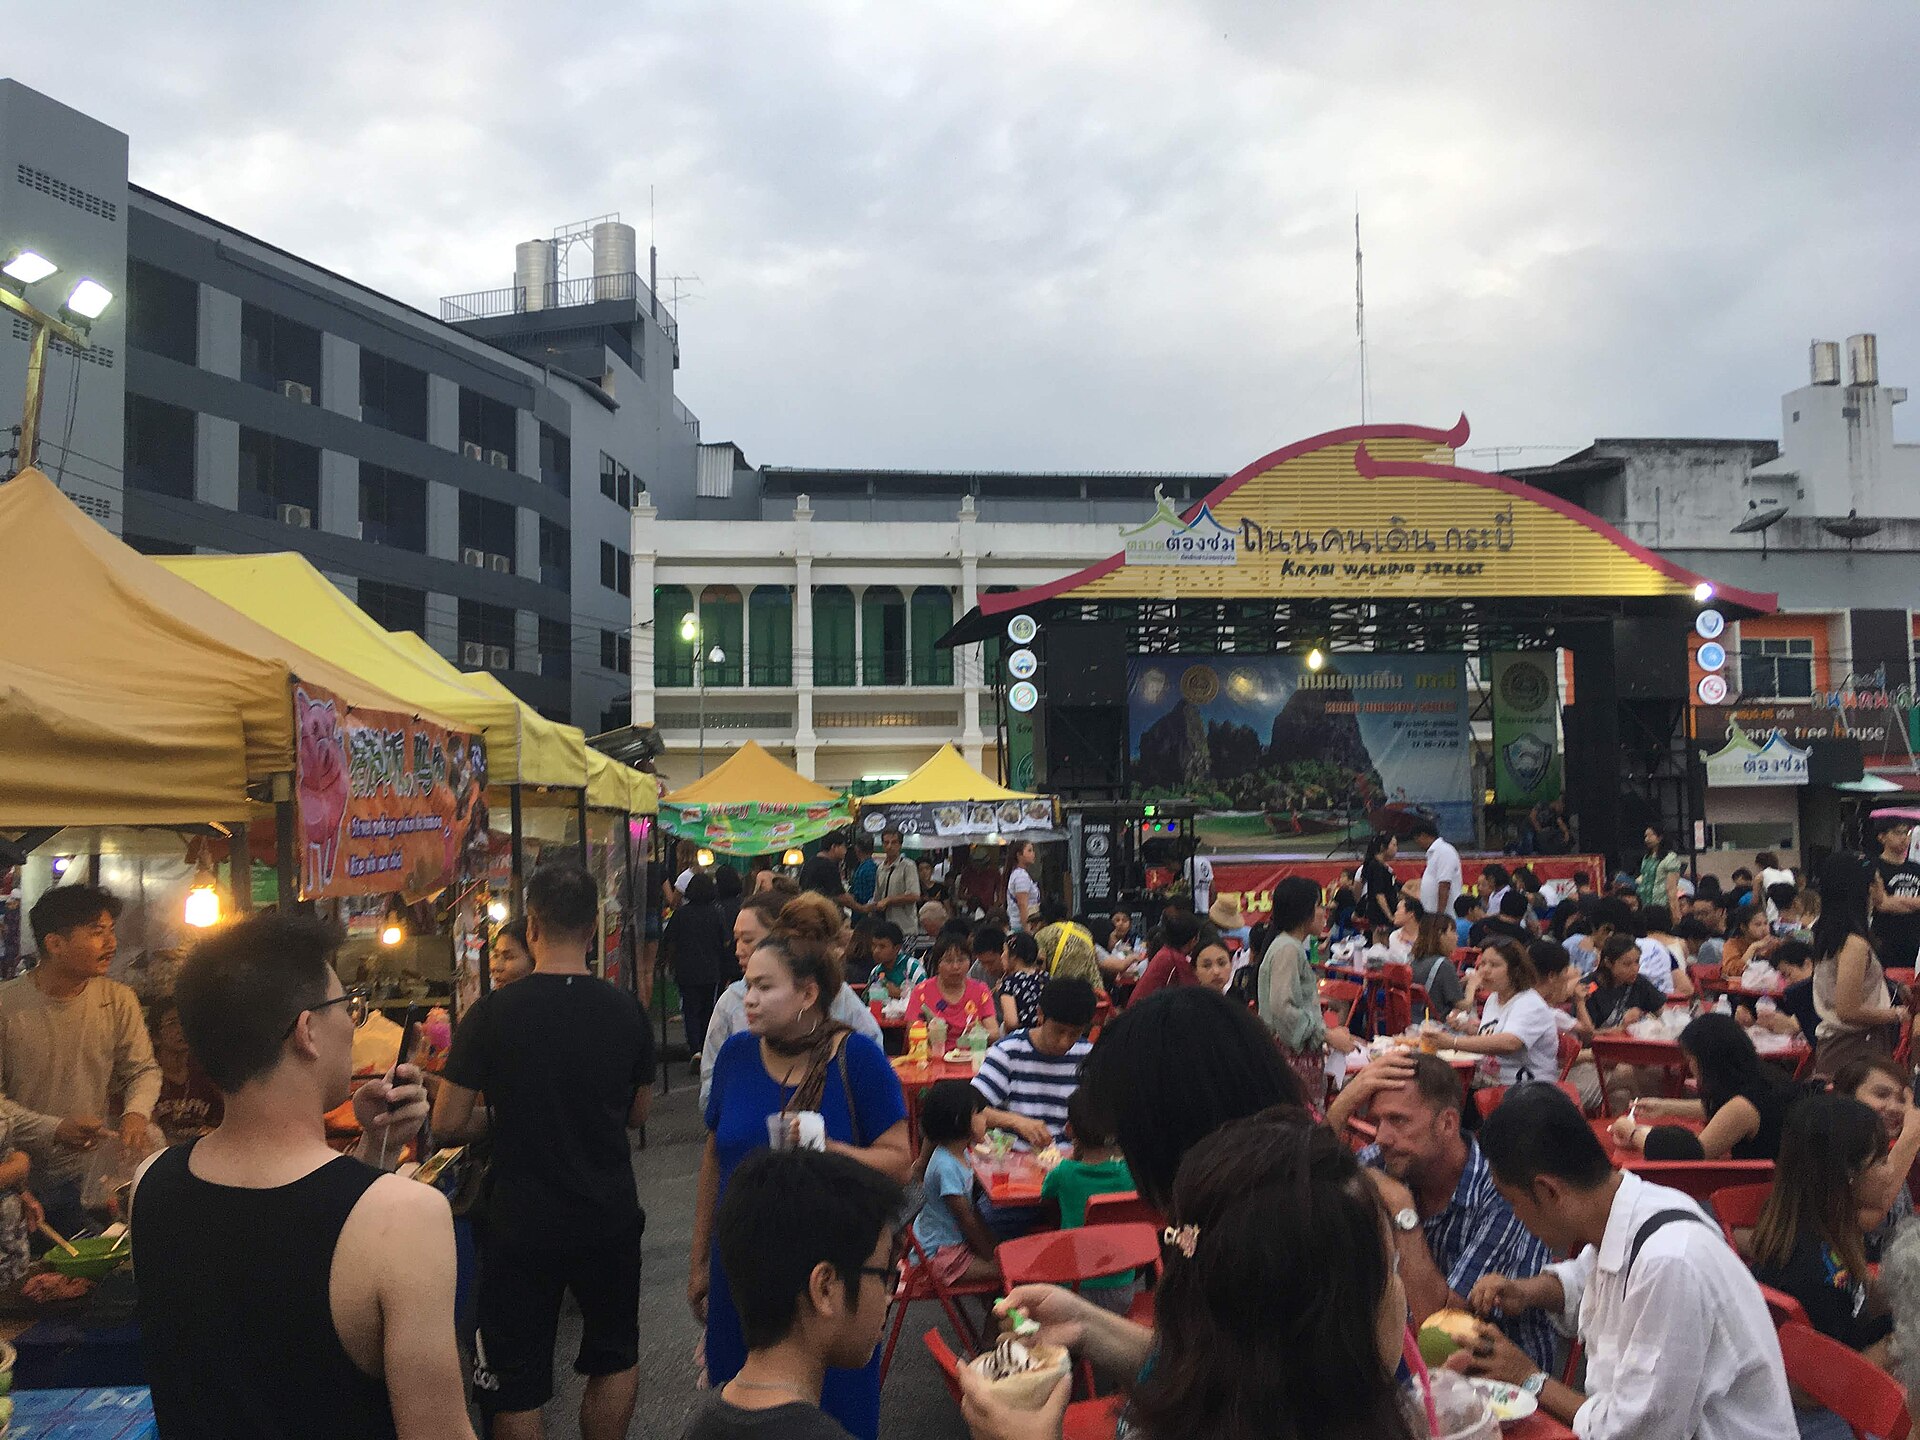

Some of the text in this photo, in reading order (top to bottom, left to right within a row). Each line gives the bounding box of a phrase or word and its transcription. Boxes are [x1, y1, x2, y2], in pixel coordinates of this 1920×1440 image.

[1241, 502, 1514, 552] ถนนคนเดิน กระบี่
[1281, 558, 1485, 578] KRABI WALKING STREET
[1725, 718, 1885, 741] Oange tree house
[898, 818, 918, 834] 69
